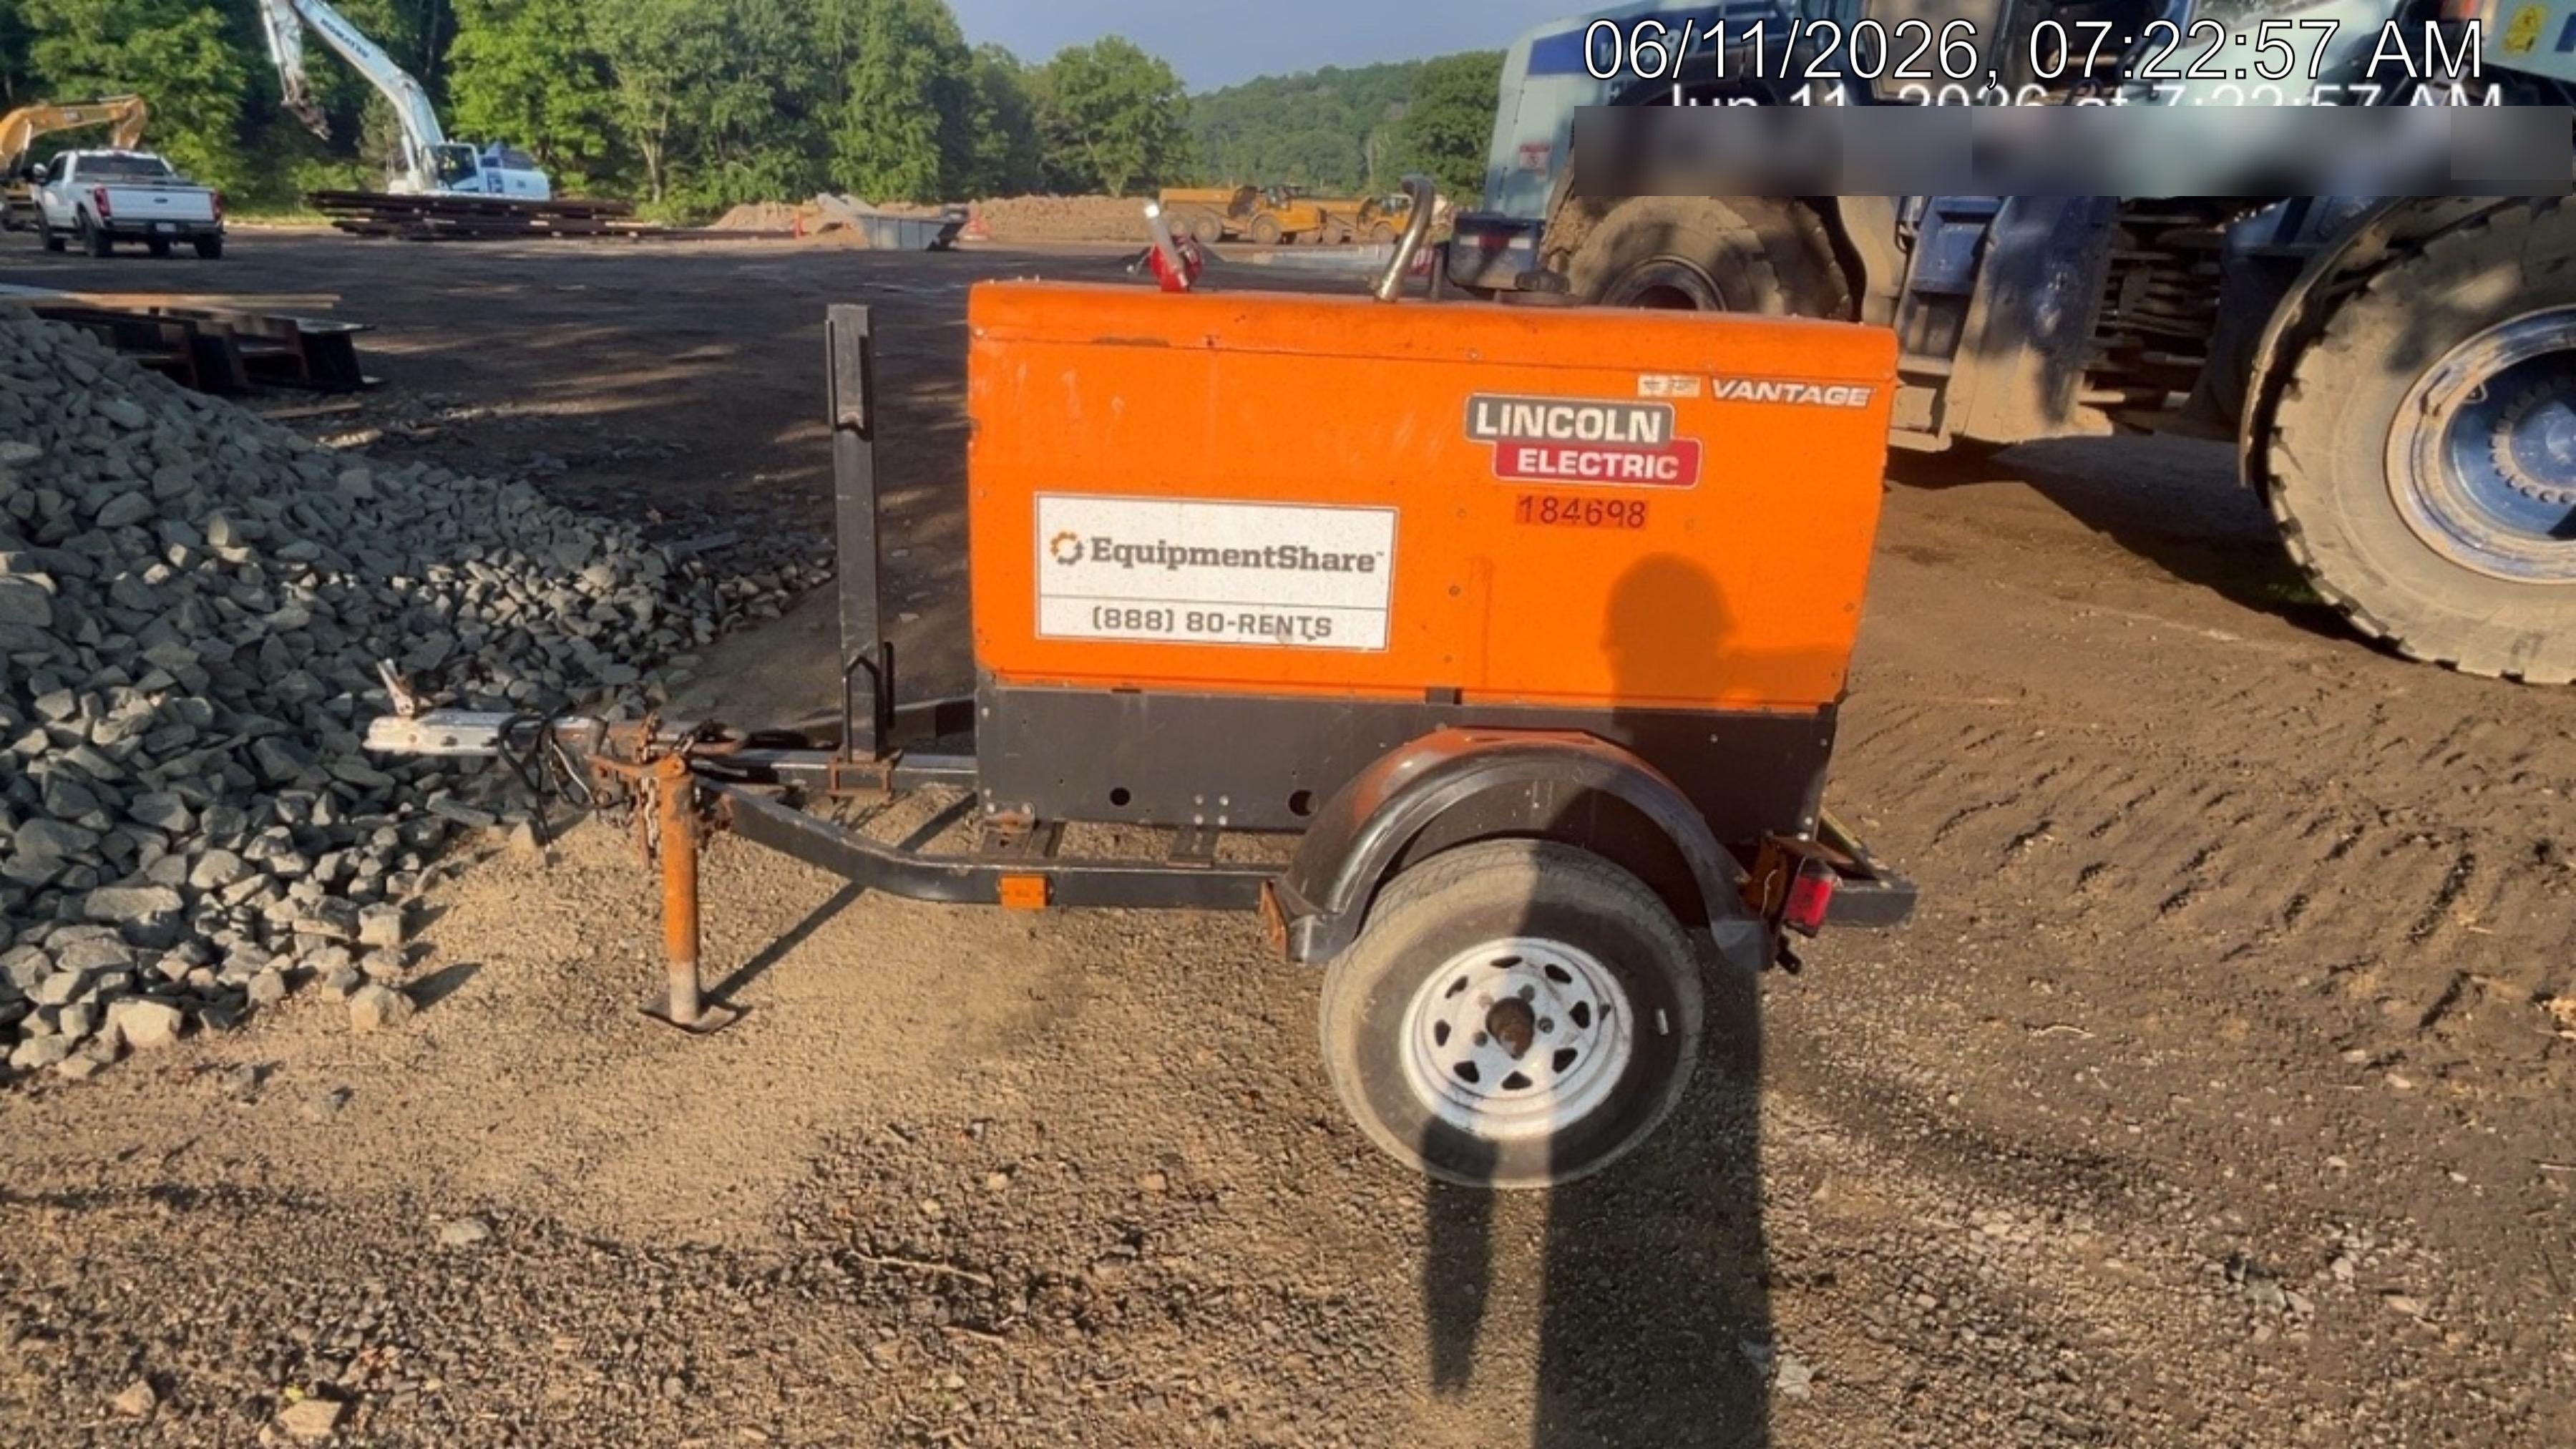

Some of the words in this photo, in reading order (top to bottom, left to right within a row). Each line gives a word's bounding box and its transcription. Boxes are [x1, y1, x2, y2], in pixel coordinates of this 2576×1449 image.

[1712, 379, 1872, 408] VANTAGE
[1475, 402, 1662, 444] LINCOLN
[1517, 448, 1680, 480] ELECTRIC
[1520, 496, 1647, 529] 184698
[1093, 605, 1174, 633] (888)
[1186, 611, 1332, 639] 80-RENTS
